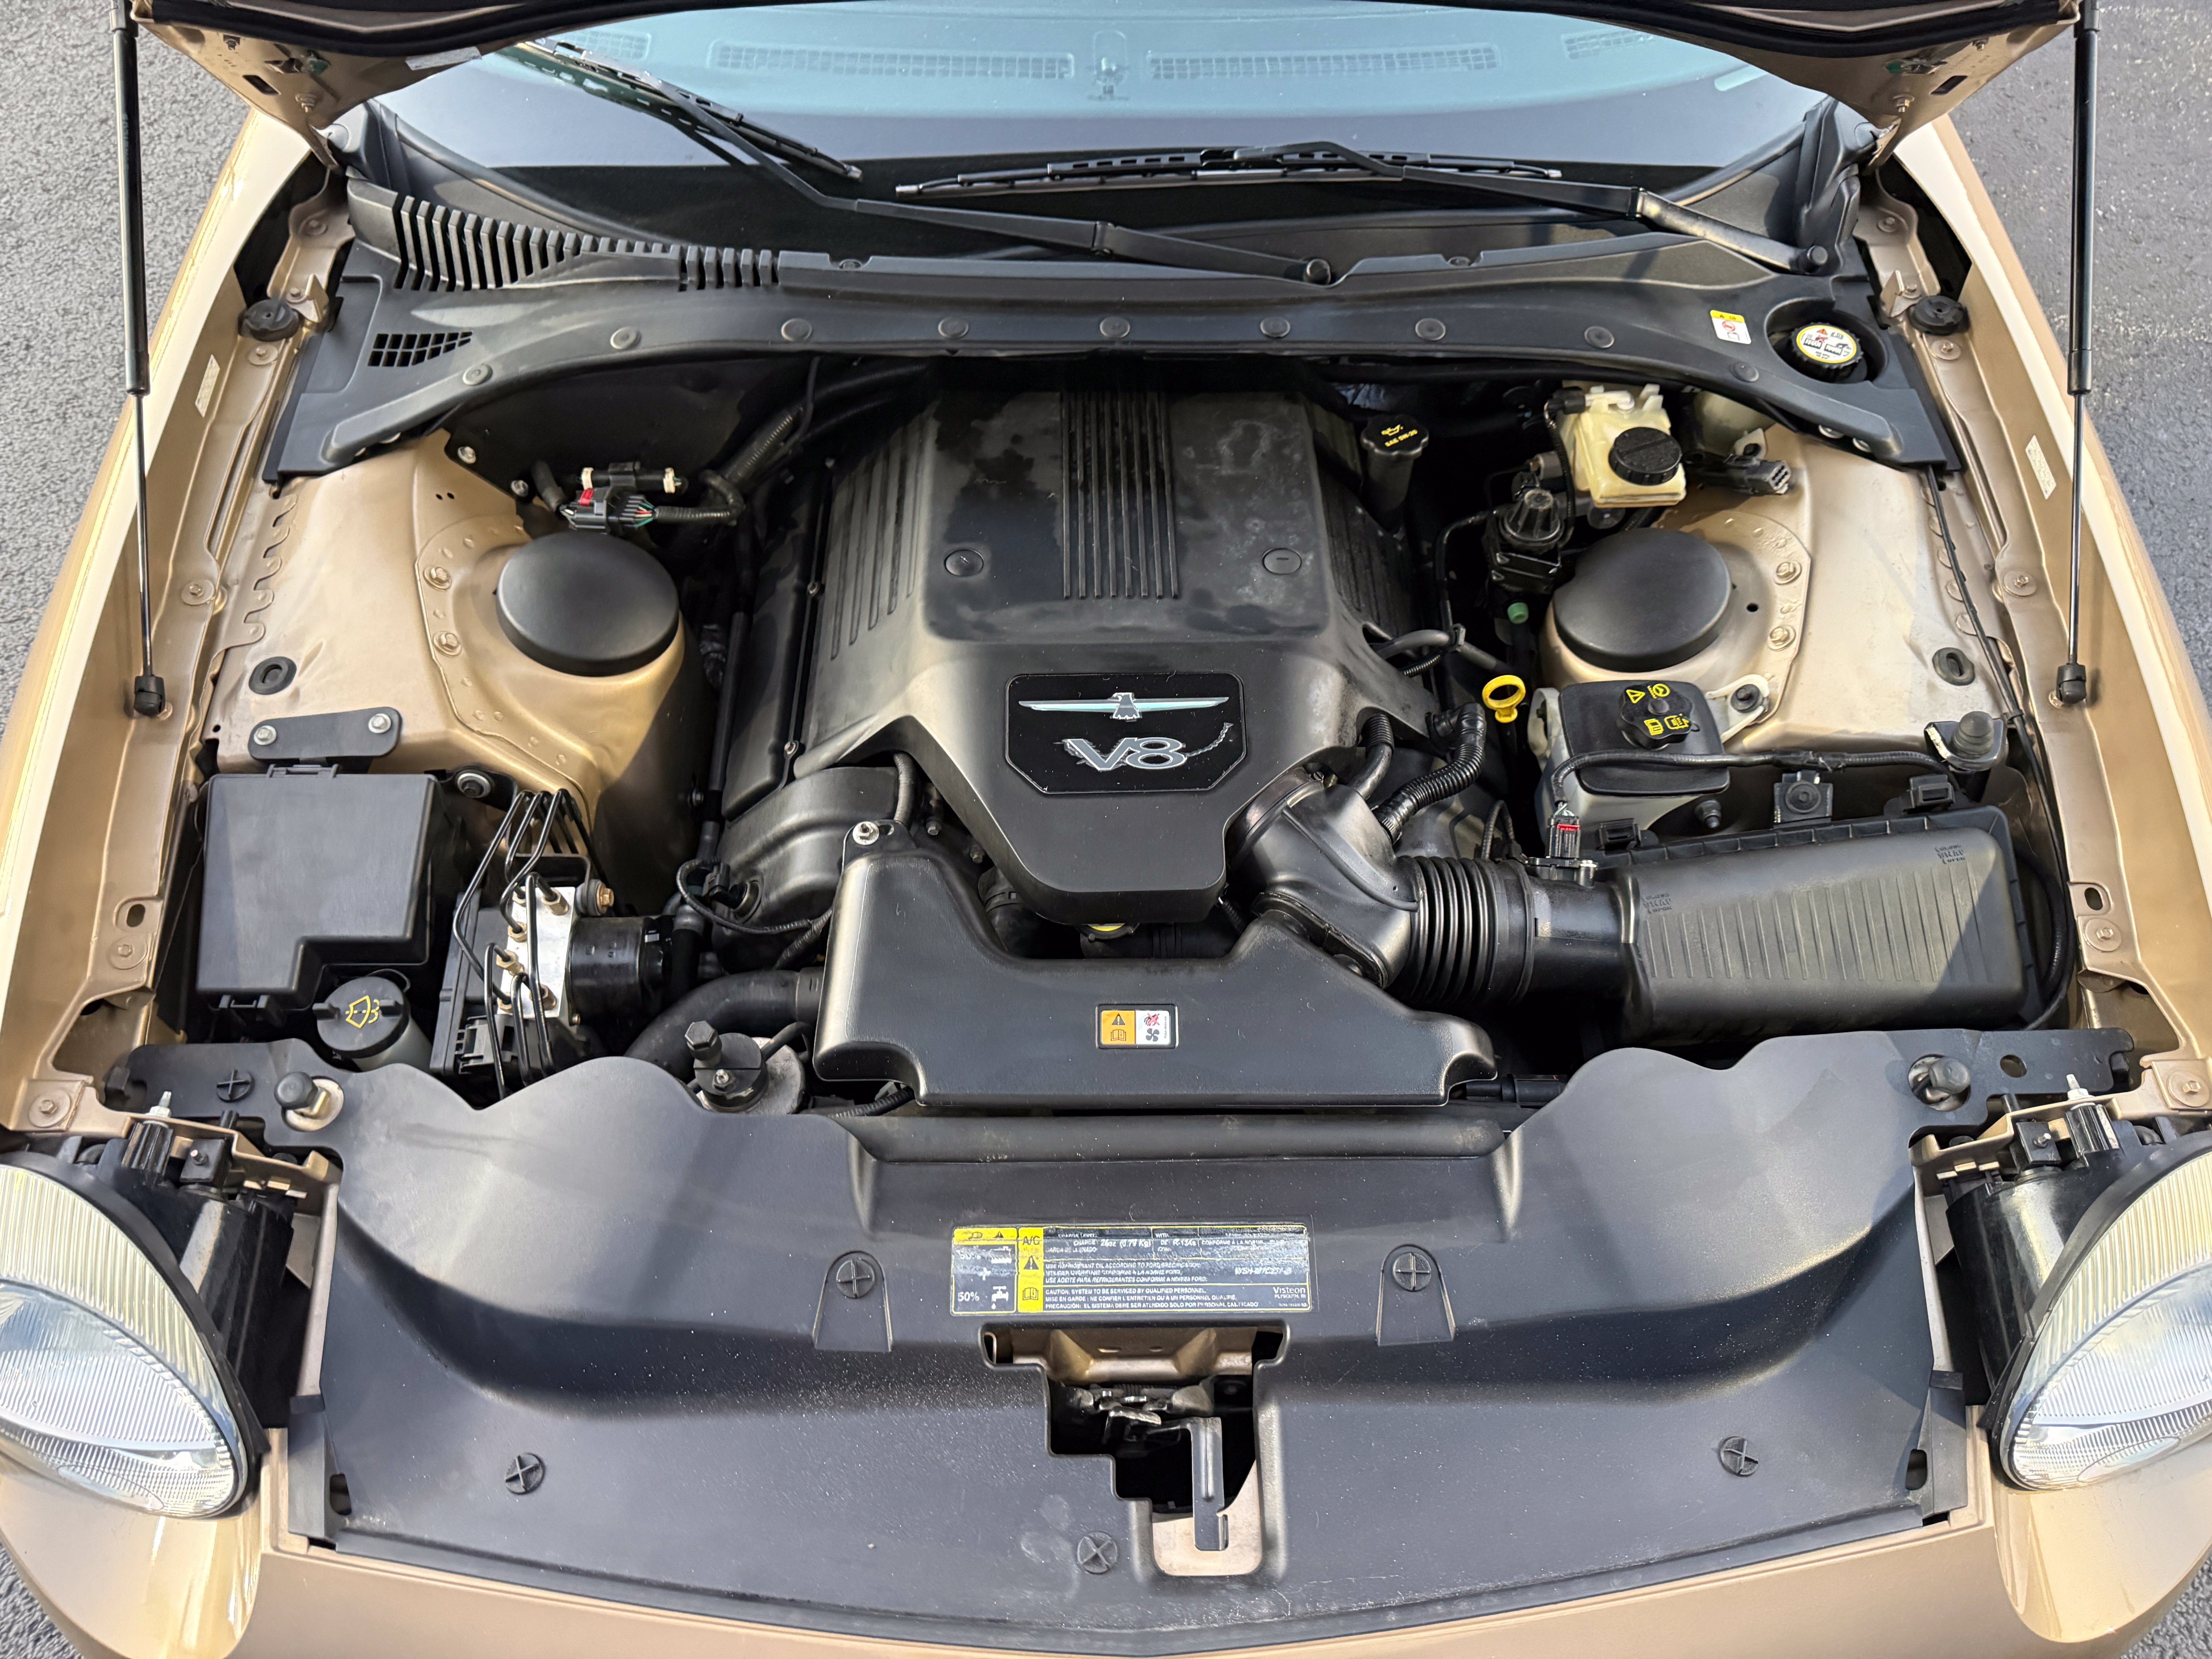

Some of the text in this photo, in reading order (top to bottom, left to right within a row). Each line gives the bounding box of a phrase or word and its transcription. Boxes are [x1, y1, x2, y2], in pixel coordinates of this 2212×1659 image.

[1066, 737, 1186, 771] V8
[1023, 1236, 1040, 1245] A/C
[1139, 1238, 1151, 1247] Kg)
[958, 1291, 980, 1302] 50%
